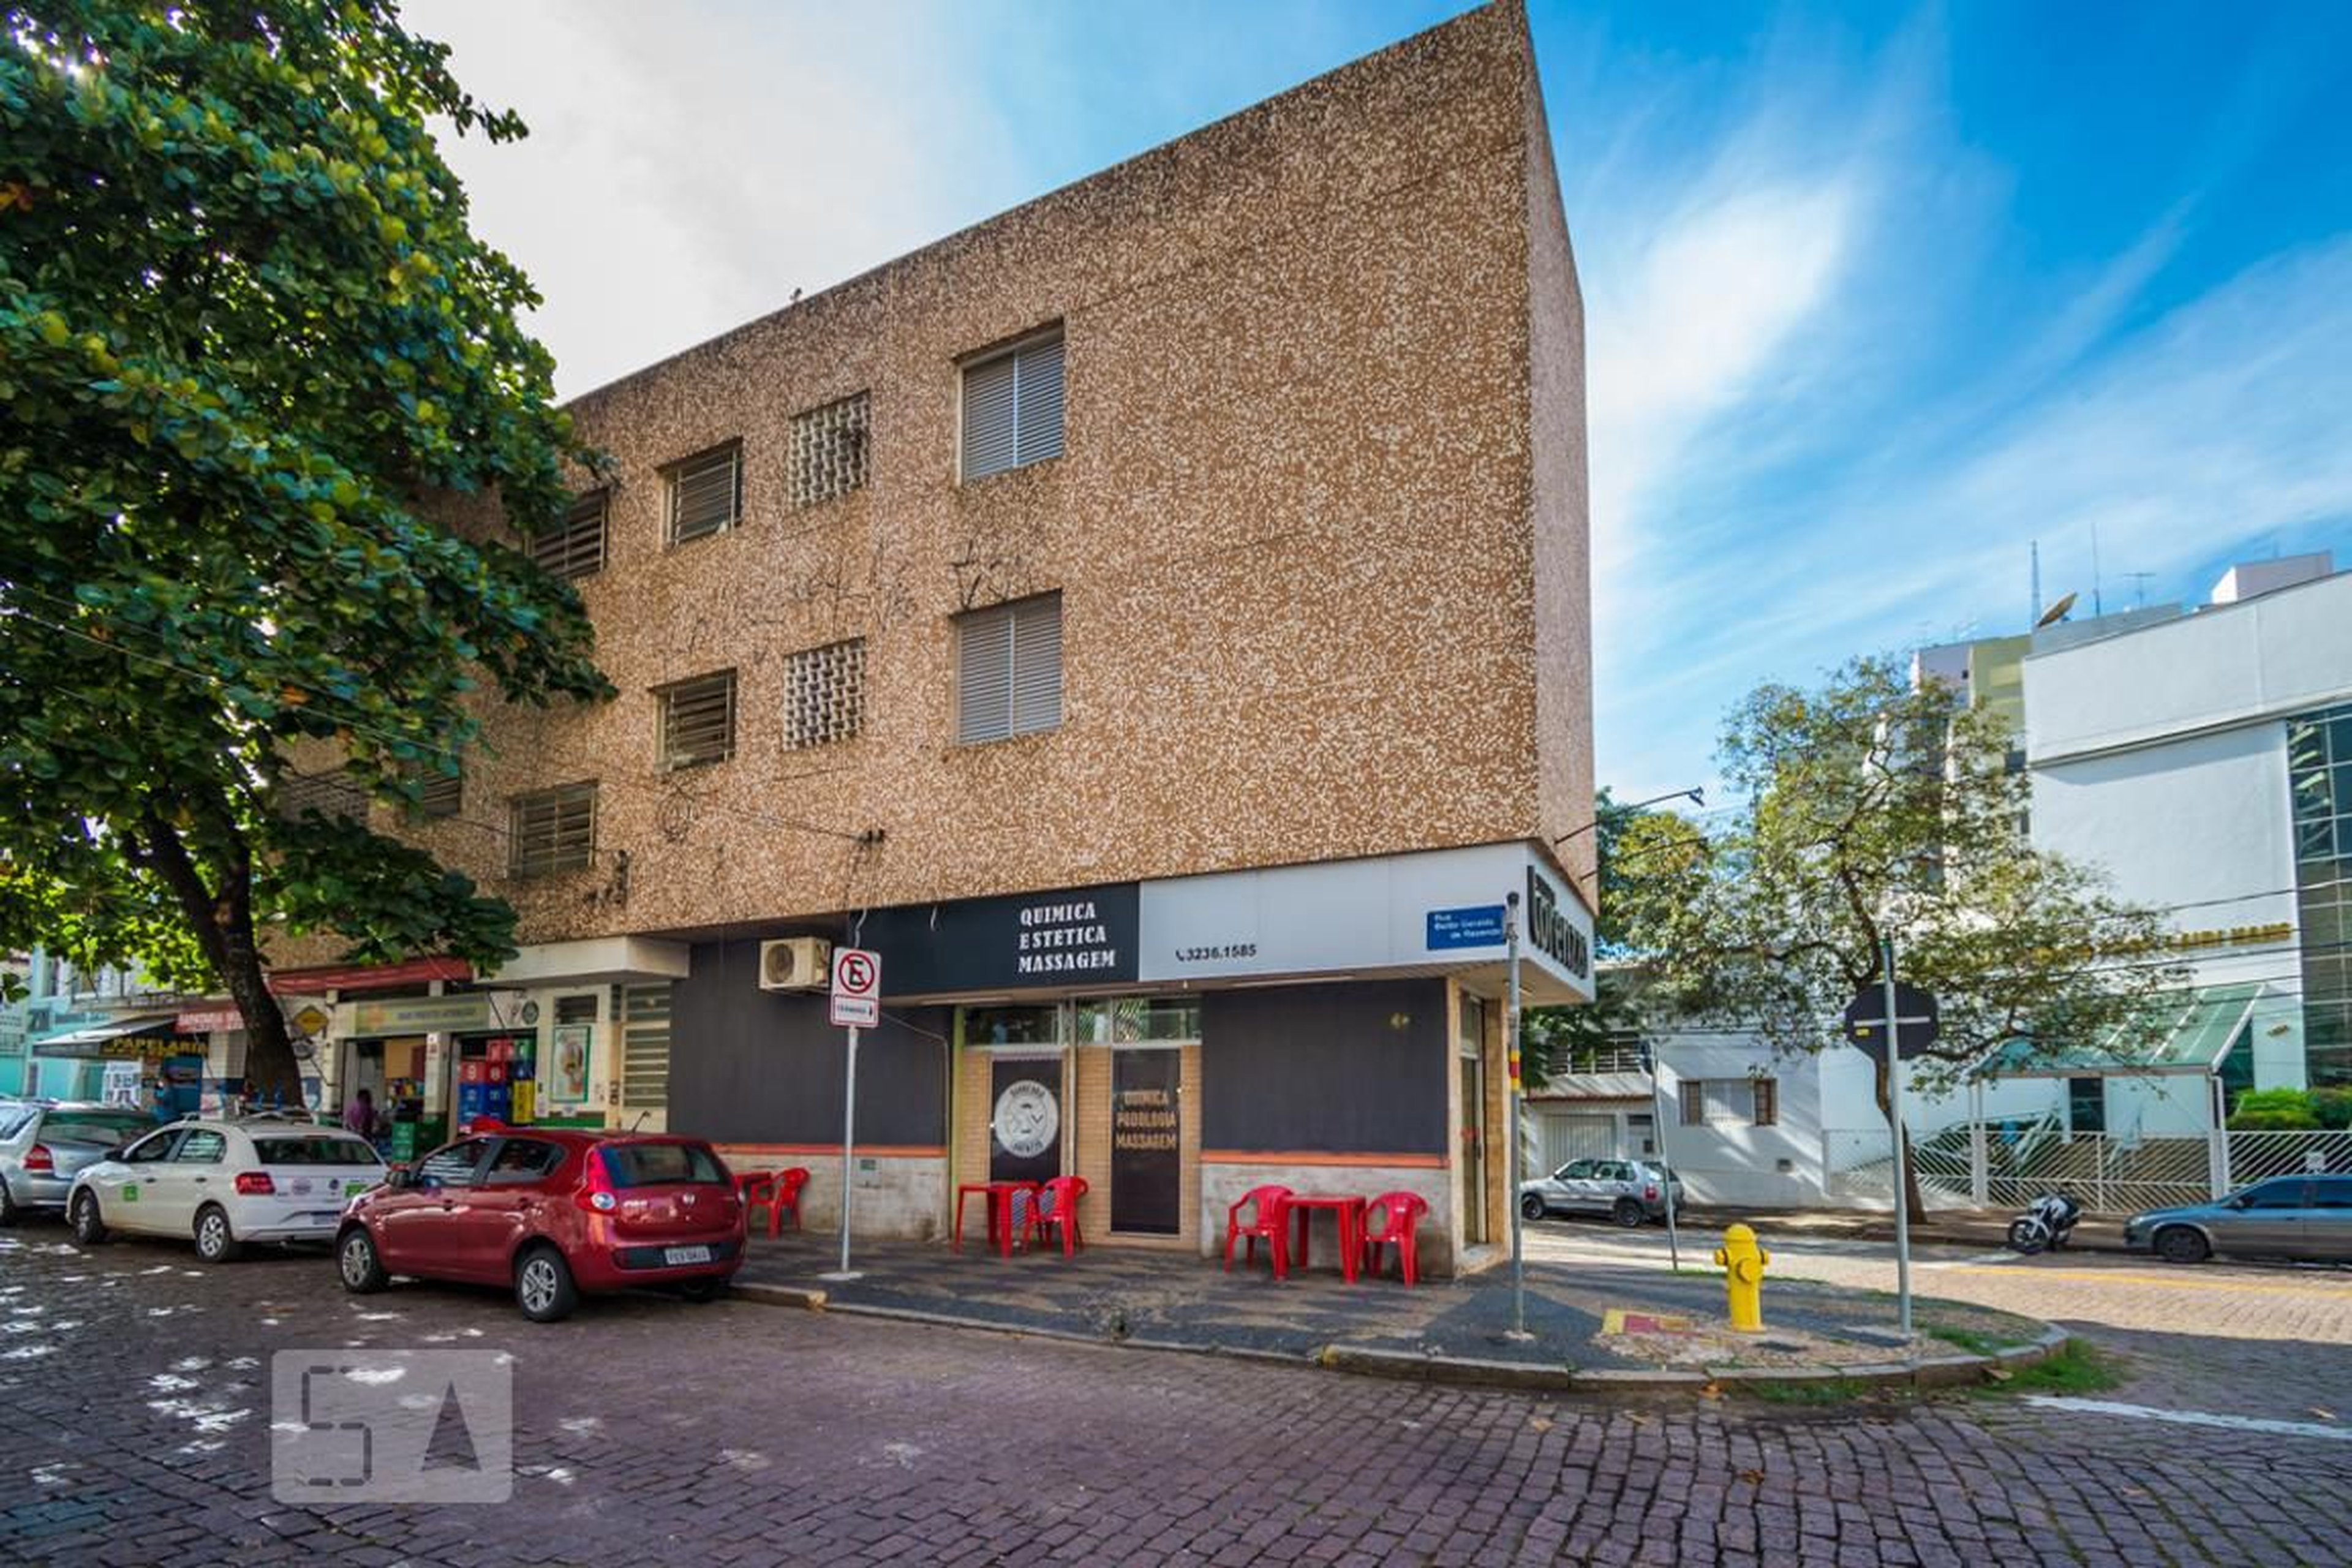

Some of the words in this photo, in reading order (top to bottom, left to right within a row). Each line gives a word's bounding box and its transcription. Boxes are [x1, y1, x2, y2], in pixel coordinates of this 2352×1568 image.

[1020, 902, 1096, 926] QUIMICA
[1019, 925, 1106, 950] ESTETICA
[1018, 950, 1116, 973] MASSAGEM
[1115, 1133, 1177, 1150] MASSAGEM
